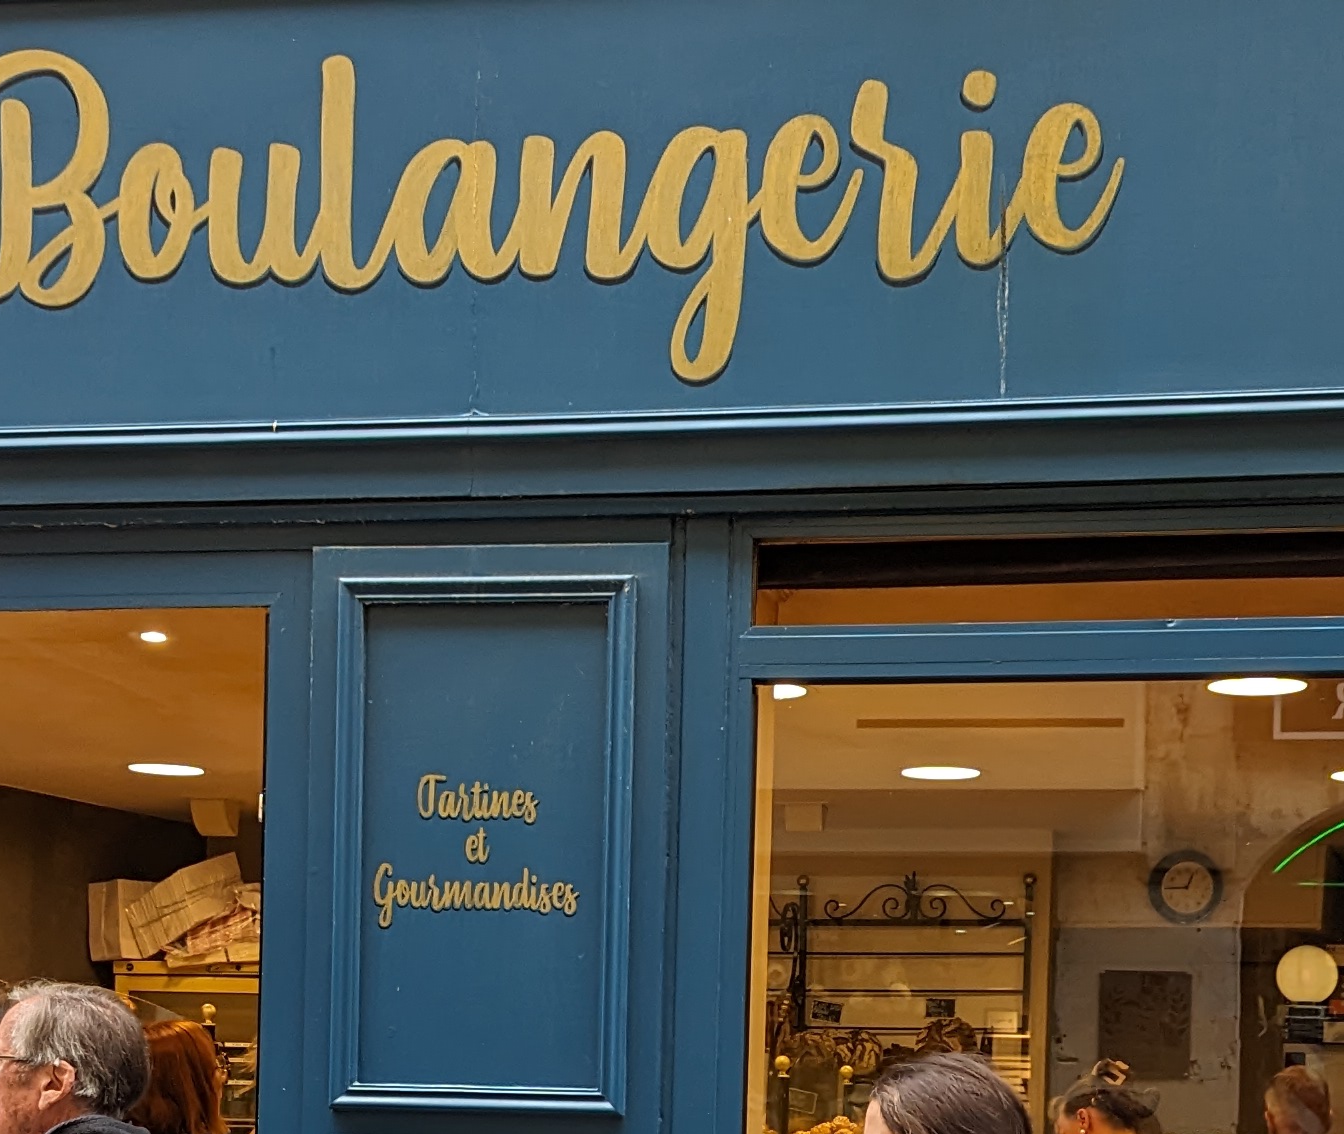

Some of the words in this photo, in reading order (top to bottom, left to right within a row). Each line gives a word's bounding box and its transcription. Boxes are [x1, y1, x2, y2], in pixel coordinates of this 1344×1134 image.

[417, 774, 540, 825] Tartines
[464, 827, 490, 863] et
[373, 862, 580, 928] Gourmandises
